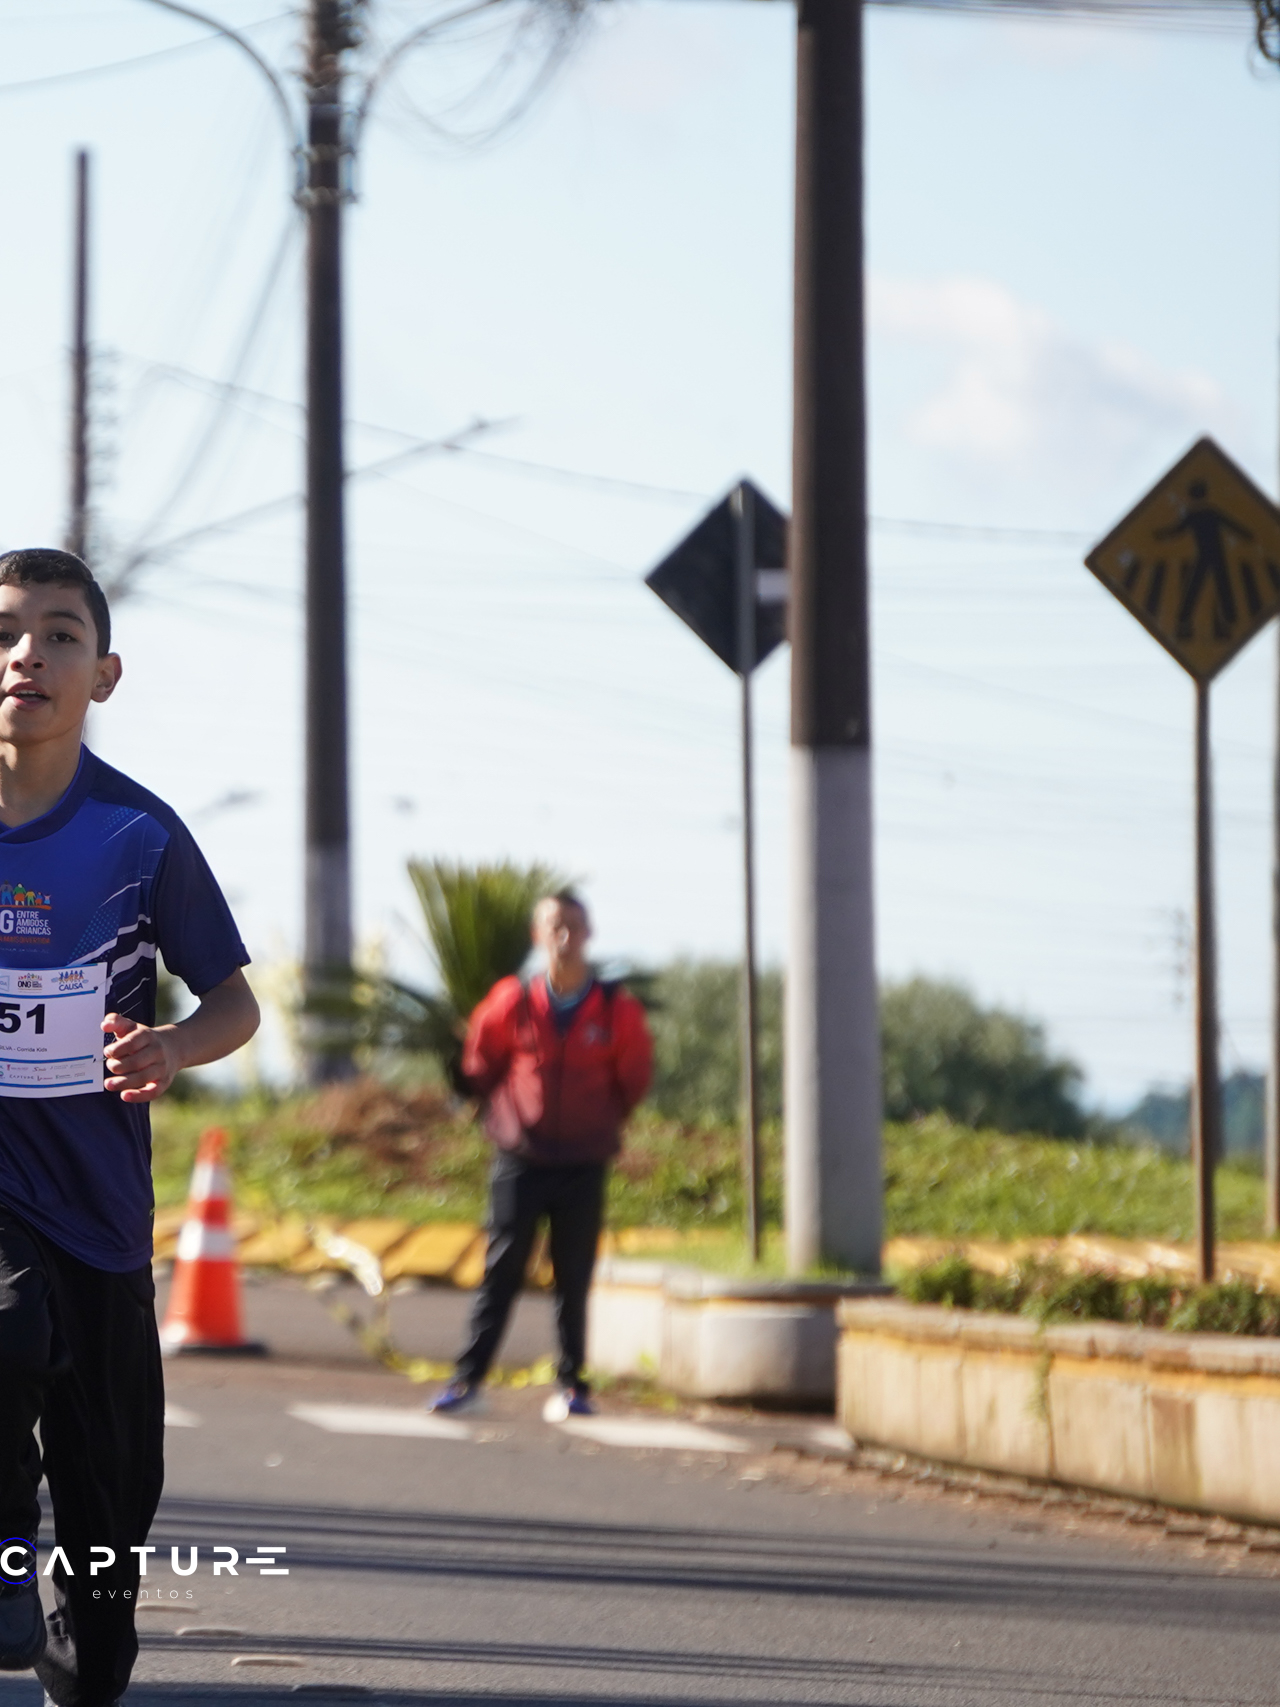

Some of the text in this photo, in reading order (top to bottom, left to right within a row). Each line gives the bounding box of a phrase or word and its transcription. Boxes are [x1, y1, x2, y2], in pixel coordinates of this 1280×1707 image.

[16, 910, 39, 919] ENTRE
[16, 919, 44, 927] AMIGOS
[17, 980, 32, 988] ONG
[58, 983, 84, 991] CAUSA
